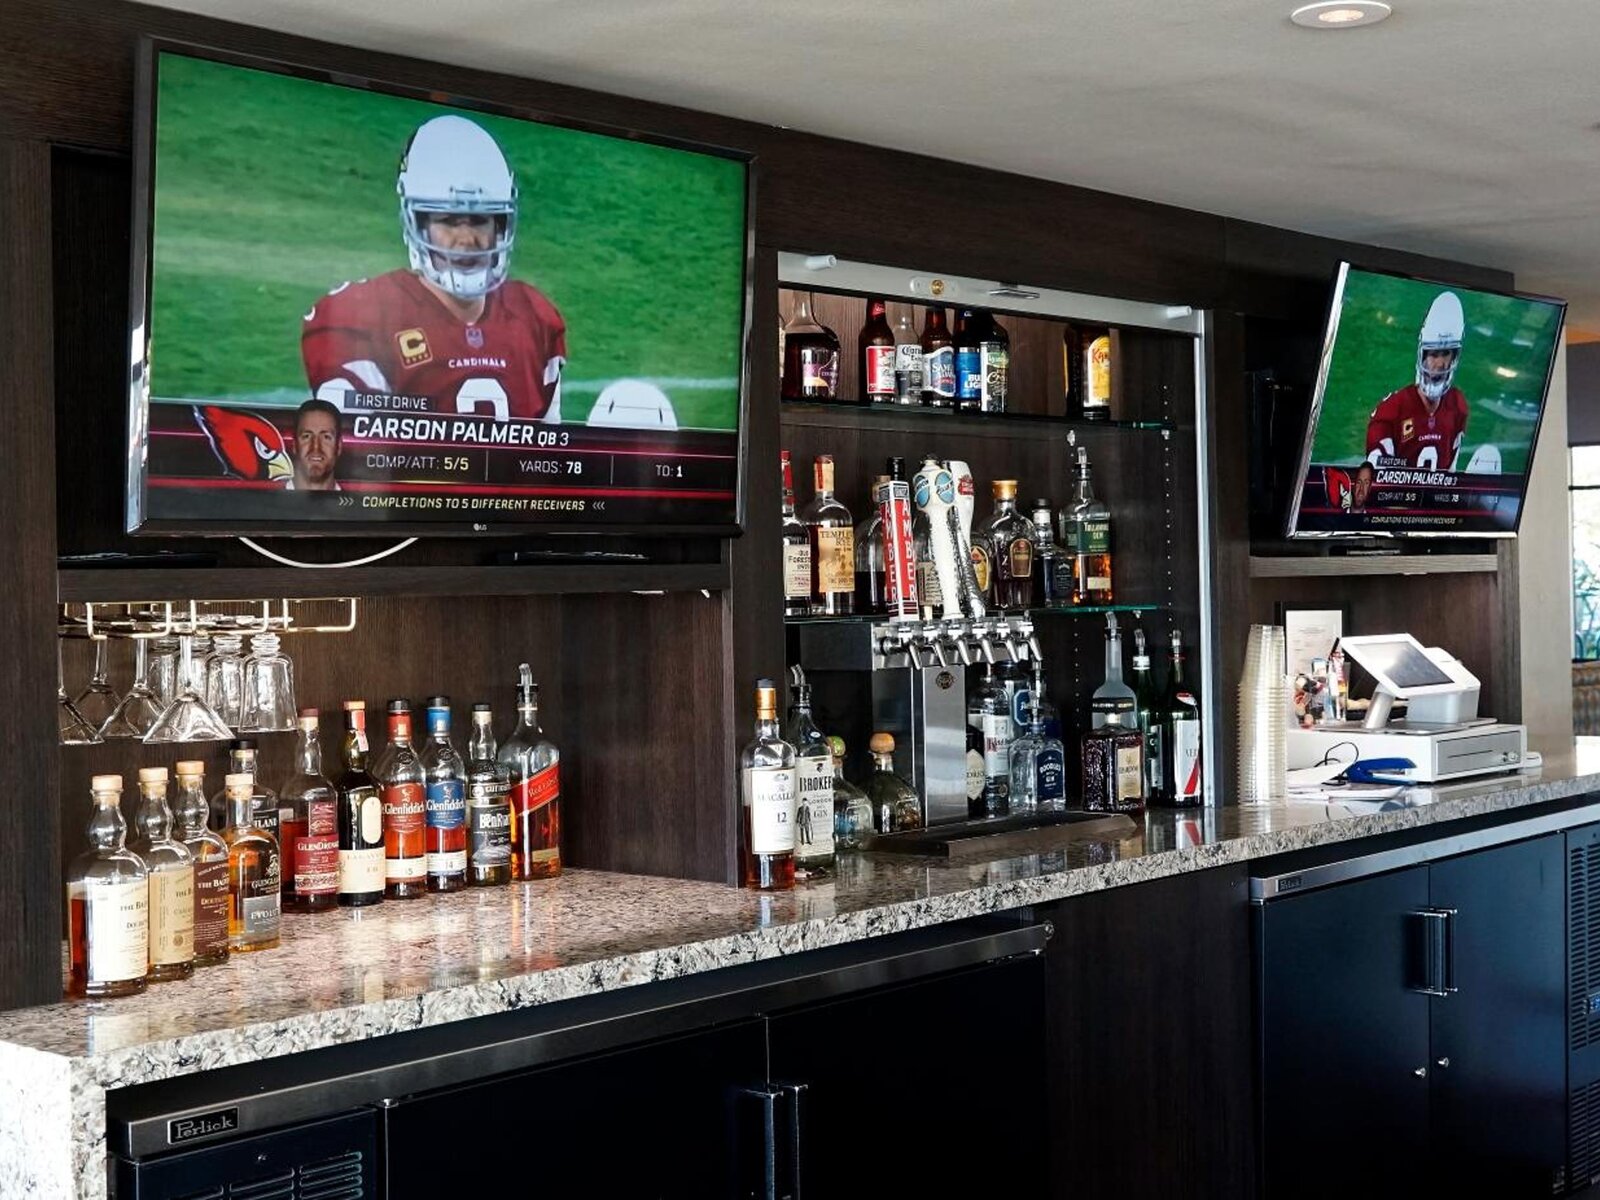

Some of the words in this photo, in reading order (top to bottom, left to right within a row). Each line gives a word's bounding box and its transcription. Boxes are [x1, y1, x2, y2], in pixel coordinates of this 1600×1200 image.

[448, 357, 506, 368] CARDINALS
[354, 393, 394, 408] FIRST
[393, 396, 428, 410] DRIVE
[353, 416, 448, 440] CARSON
[452, 421, 534, 444] PALMER
[537, 431, 557, 448] QB
[559, 433, 570, 446] 3
[366, 454, 440, 470] COMP/ATT:
[444, 457, 469, 471] 5/5
[519, 460, 562, 474] YARDS:
[566, 461, 582, 474] 78
[676, 465, 683, 478] 1
[1376, 470, 1411, 484] CARSON
[1411, 471, 1445, 485] PALMER
[362, 496, 443, 508] COMPLETIONS
[445, 498, 460, 508] TO
[461, 498, 468, 509] 5
[471, 498, 528, 510] DIFFERENT
[530, 499, 585, 511] RECEIVERS
[902, 500, 917, 601] AMBER
[777, 812, 787, 823] 12
[175, 1115, 234, 1139] Perlick
